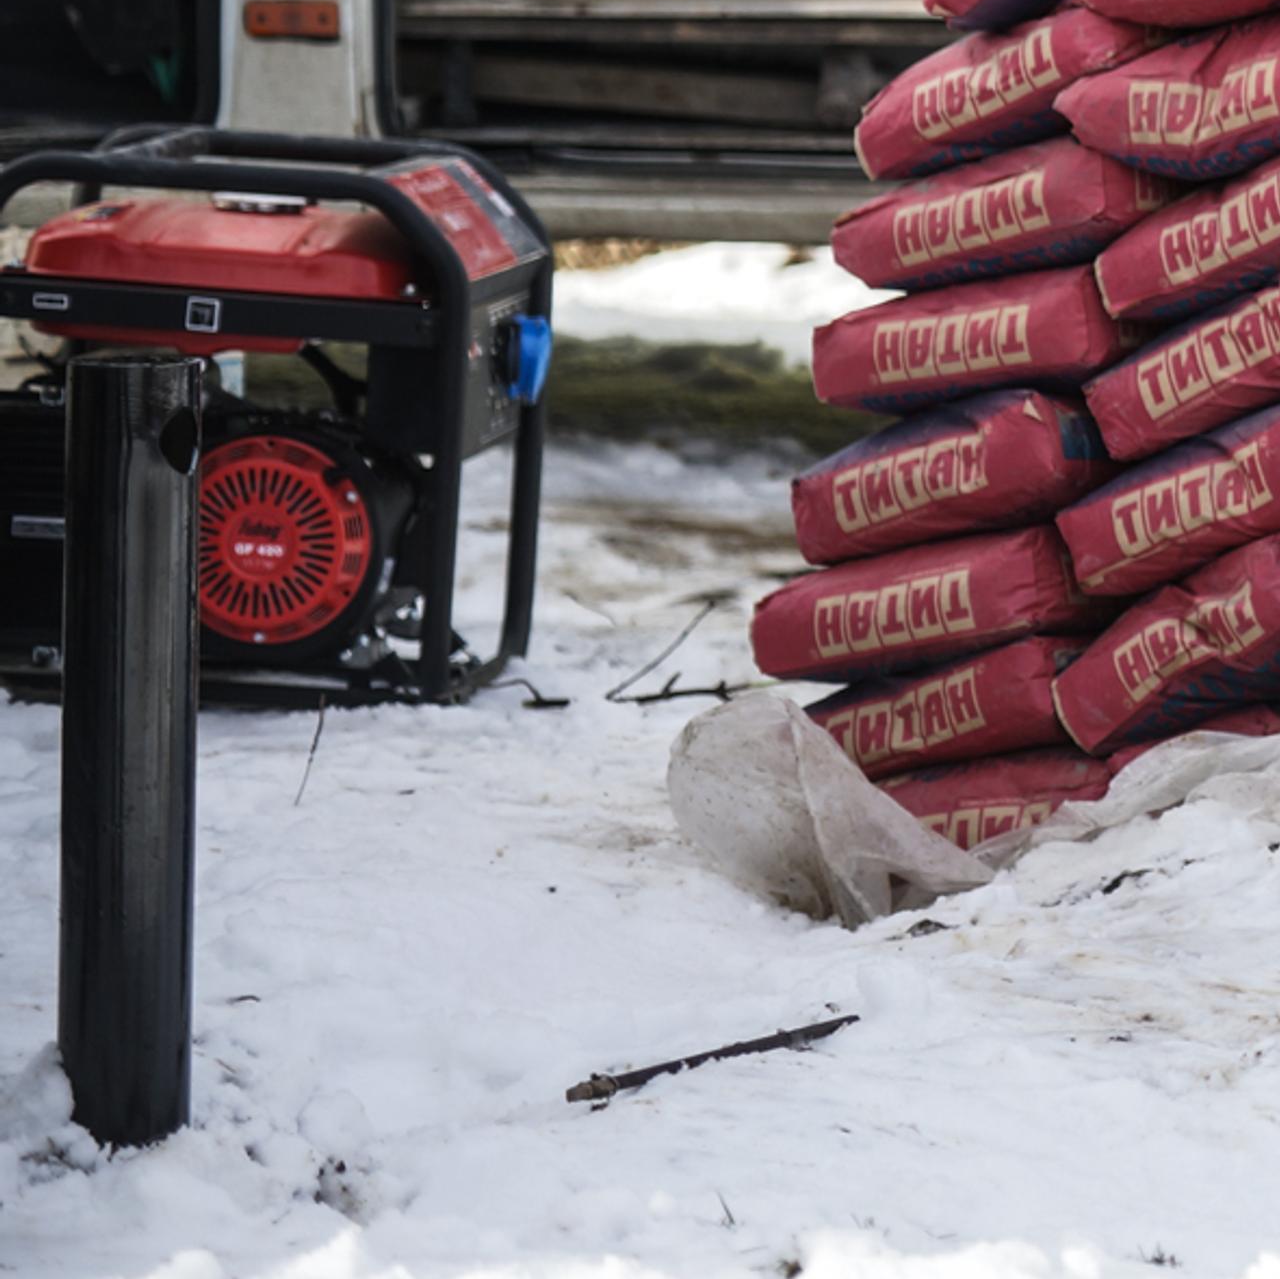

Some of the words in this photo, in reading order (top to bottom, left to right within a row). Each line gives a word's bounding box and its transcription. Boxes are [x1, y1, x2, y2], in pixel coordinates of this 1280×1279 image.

[913, 27, 1059, 138] ТИТАН
[894, 170, 1050, 266] ТИТАН
[874, 304, 1030, 382] ТИТАН
[834, 433, 987, 532] ТИТАН
[1114, 444, 1272, 558] ТИТАН
[815, 570, 975, 657] ТИТАН
